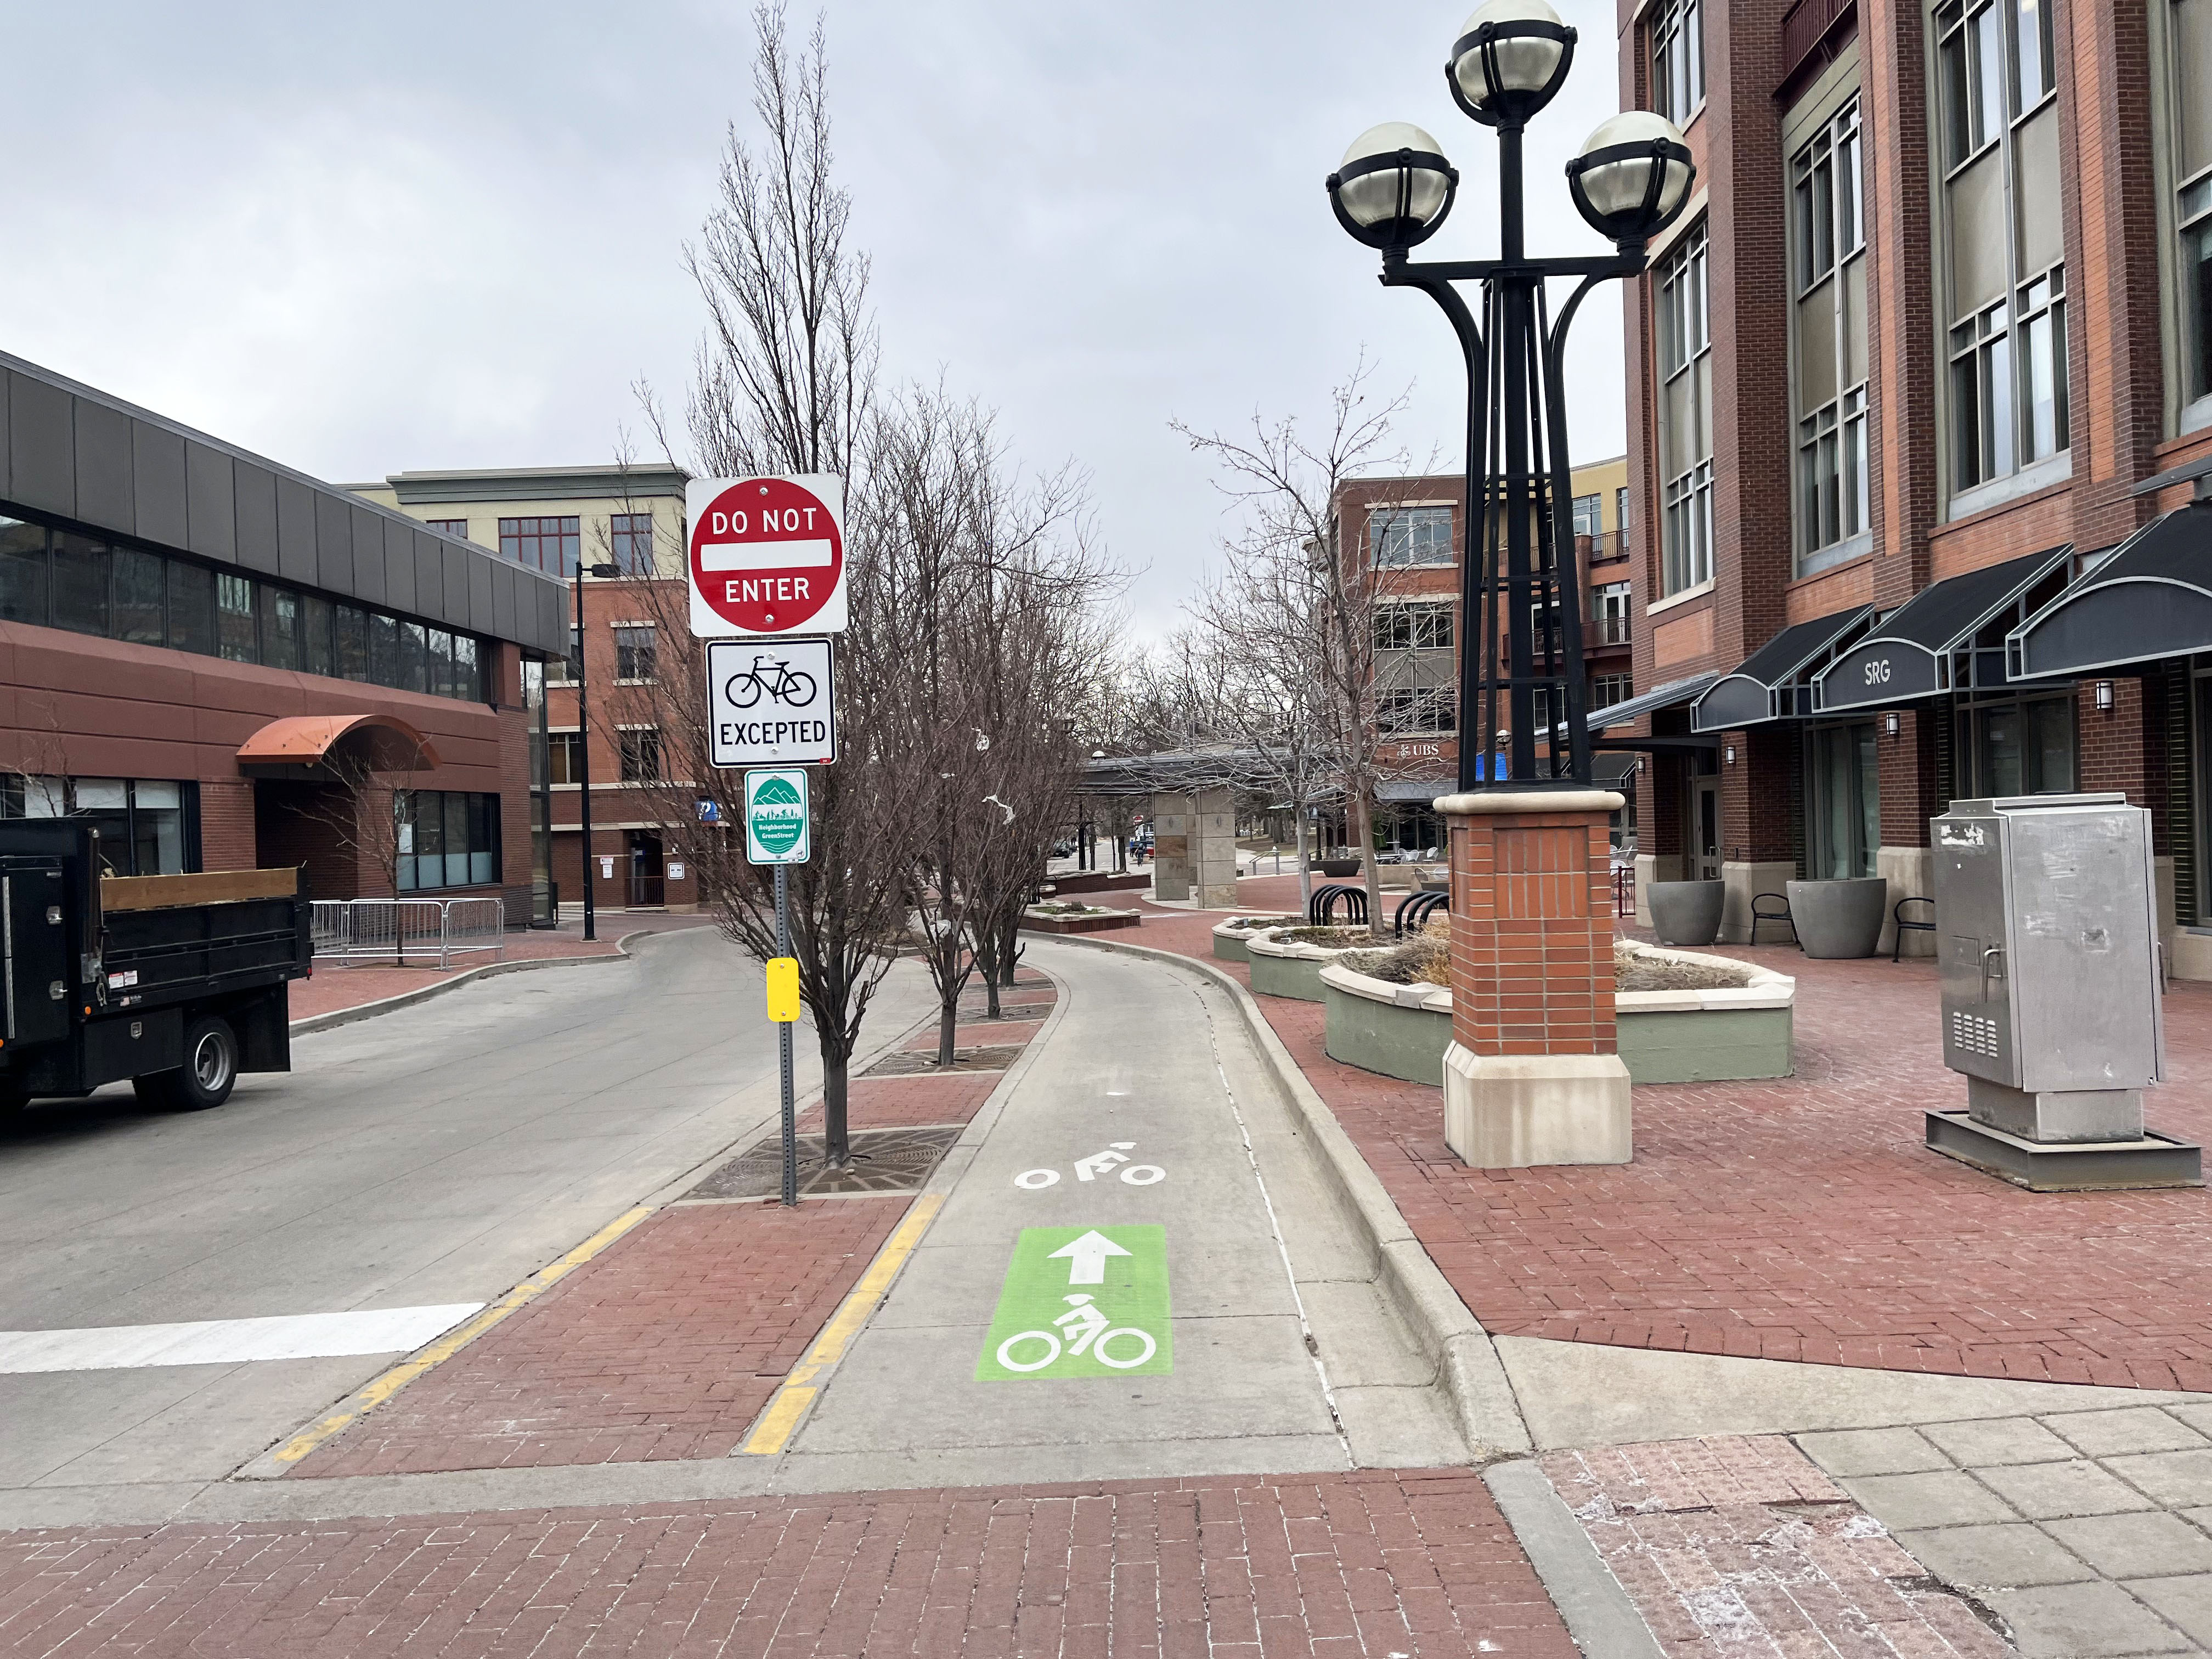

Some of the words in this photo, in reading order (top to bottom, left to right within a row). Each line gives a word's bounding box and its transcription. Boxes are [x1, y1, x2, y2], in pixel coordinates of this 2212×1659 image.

[712, 511, 748, 535] DO
[763, 507, 817, 532] NOT
[725, 578, 810, 603] ENTER
[1865, 659, 1891, 685] SRG
[720, 720, 826, 745] EXCEPTED
[1413, 744, 1439, 756] UBS
